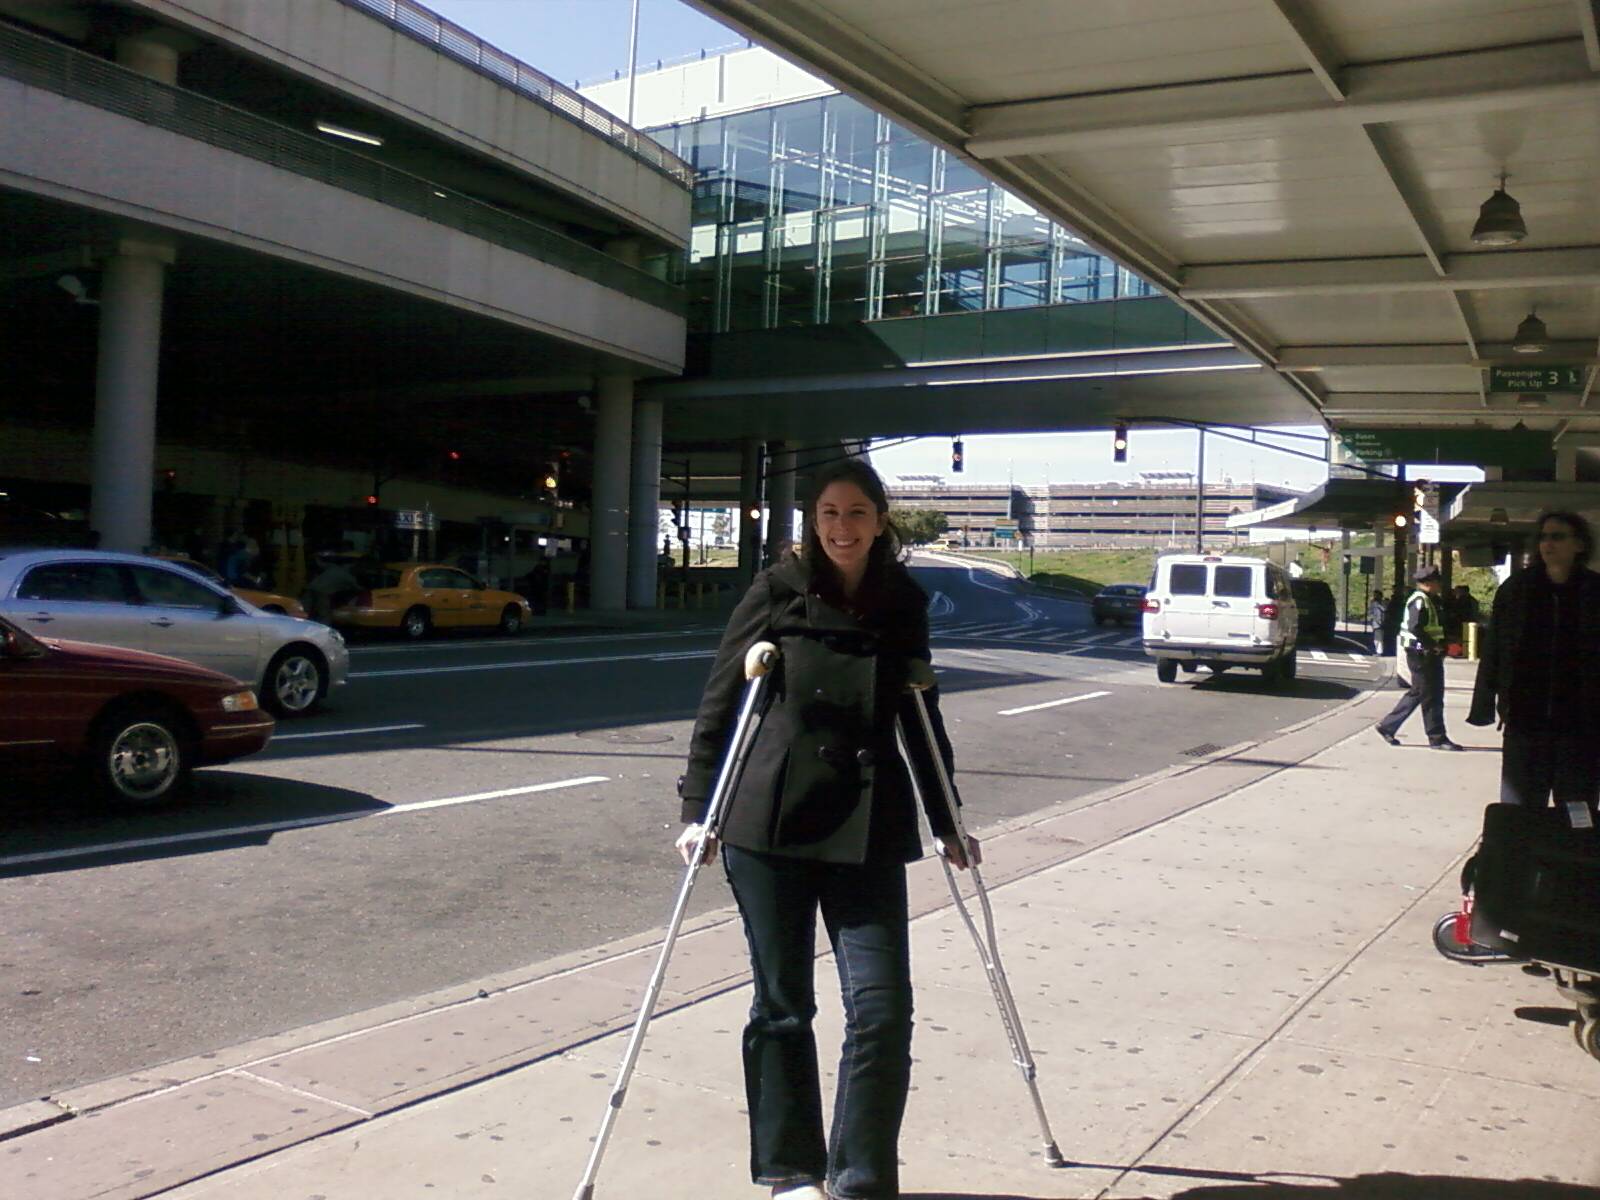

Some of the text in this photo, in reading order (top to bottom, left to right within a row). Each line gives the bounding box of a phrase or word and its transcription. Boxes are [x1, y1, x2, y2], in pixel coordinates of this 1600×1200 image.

[1496, 369, 1542, 378] Passenger
[1548, 371, 1559, 385] 3
[1508, 380, 1527, 388] Pick
